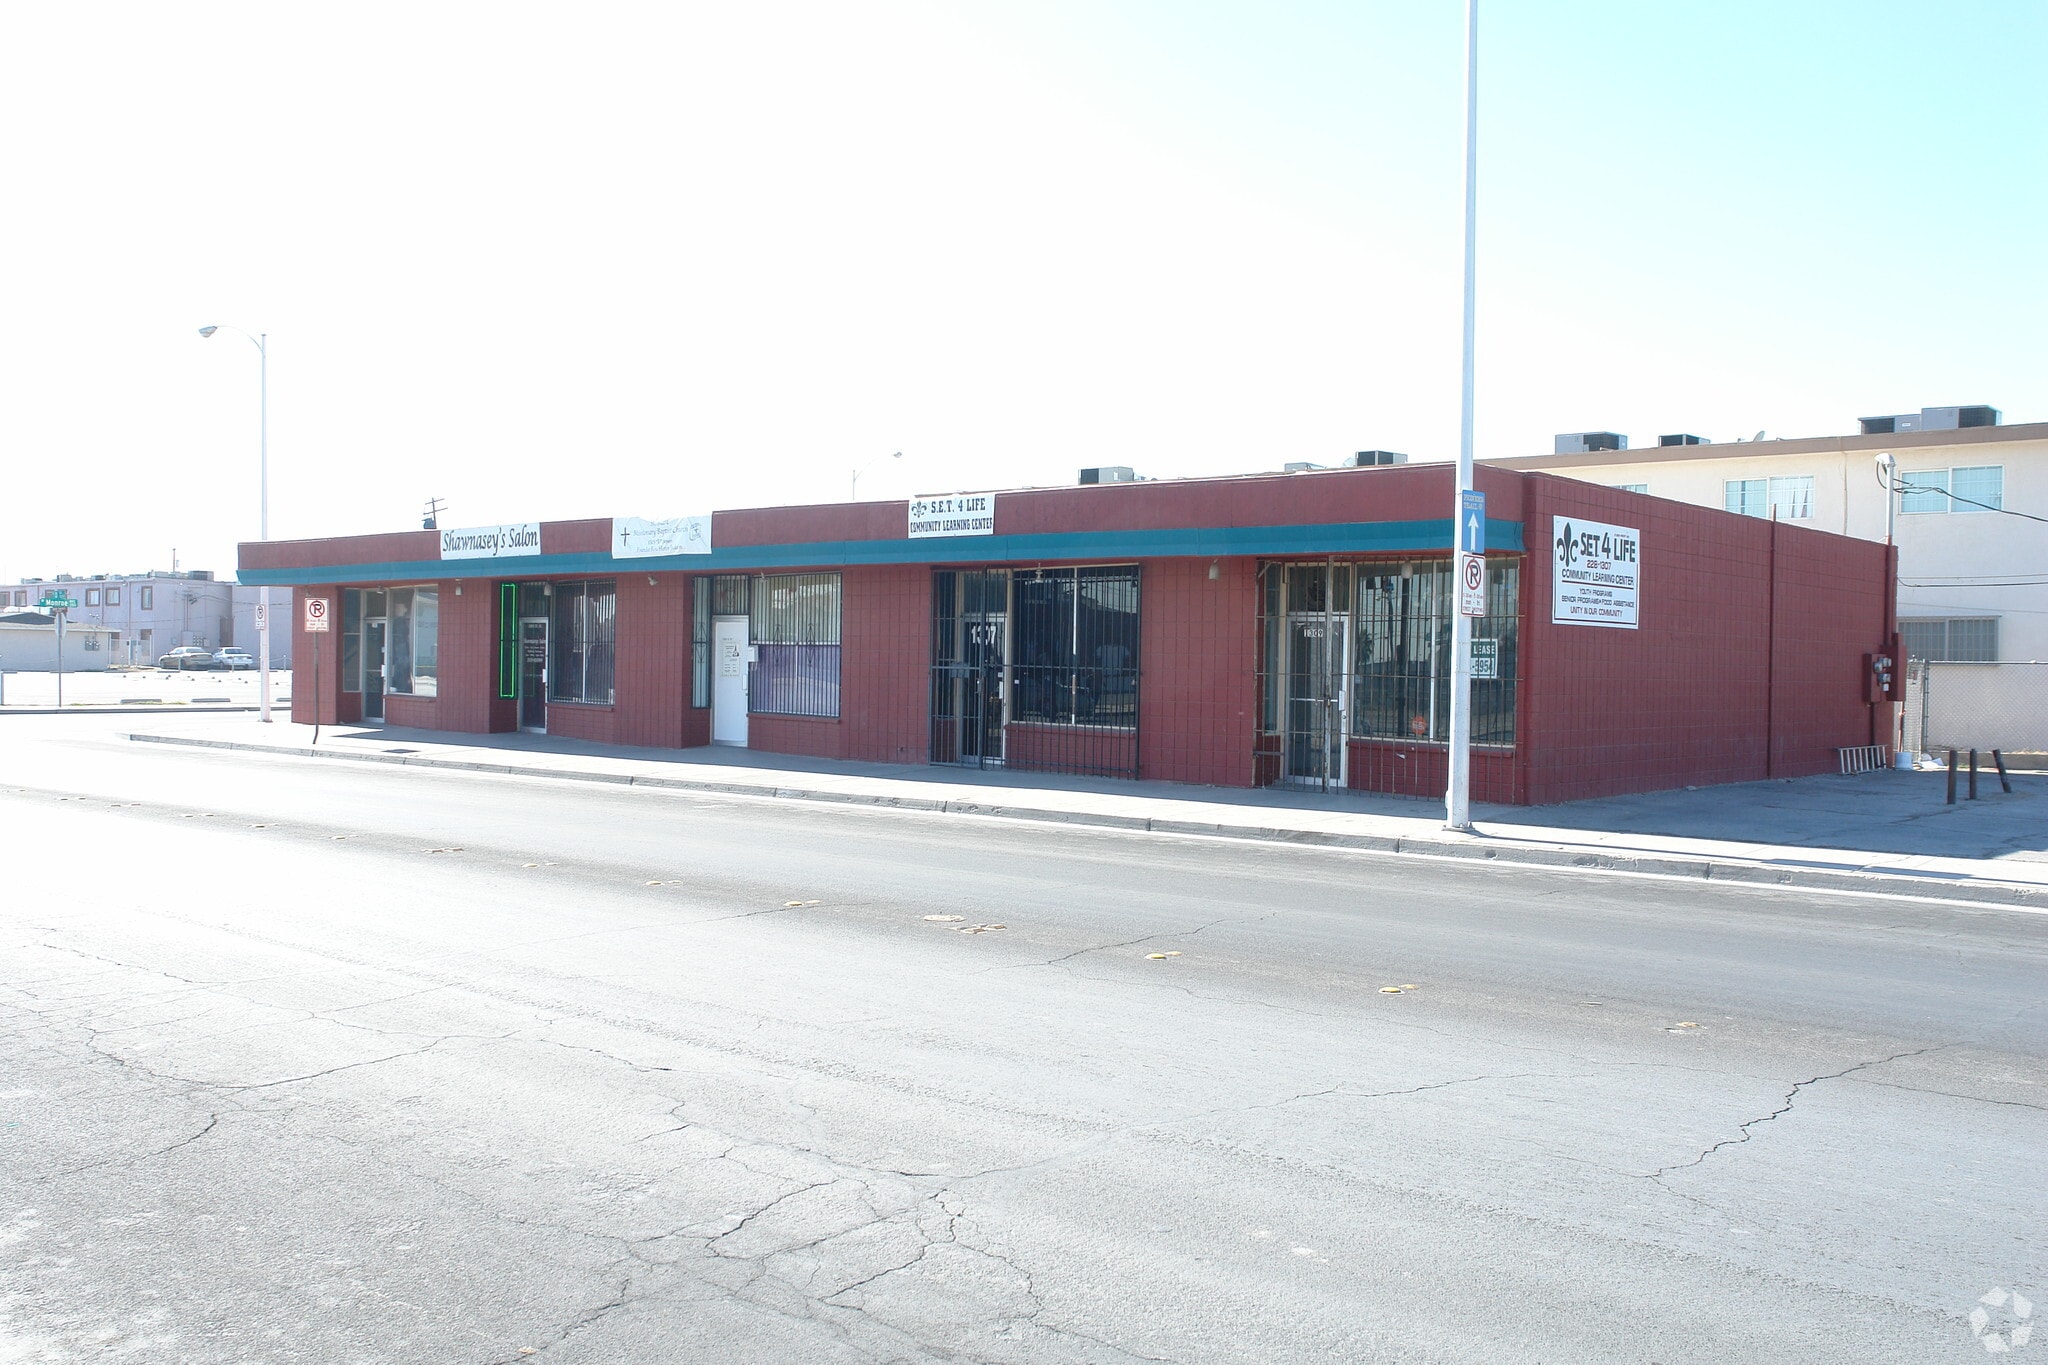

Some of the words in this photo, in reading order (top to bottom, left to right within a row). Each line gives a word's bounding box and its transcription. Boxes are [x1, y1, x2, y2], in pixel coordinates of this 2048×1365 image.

[931, 500, 955, 513] S.E.T.
[958, 499, 963, 512] 4
[966, 498, 986, 511] LIFE
[910, 521, 941, 533] COMMUNITY
[942, 519, 970, 531] LEARNING
[443, 526, 506, 556] Shawnasey's
[509, 524, 539, 548] Salon
[1601, 532, 1611, 559] 4
[1613, 538, 1636, 562] LIFE
[1562, 569, 1591, 581] COMMUNITY
[1592, 572, 1615, 583] LEARNING
[1615, 575, 1635, 586] CENTER
[45, 599, 69, 607] Monroe
[1570, 606, 1584, 614] UNITY
[1598, 609, 1623, 617] COMMUNITY
[1304, 629, 1323, 638] 1309
[1473, 645, 1495, 654] LEASE
